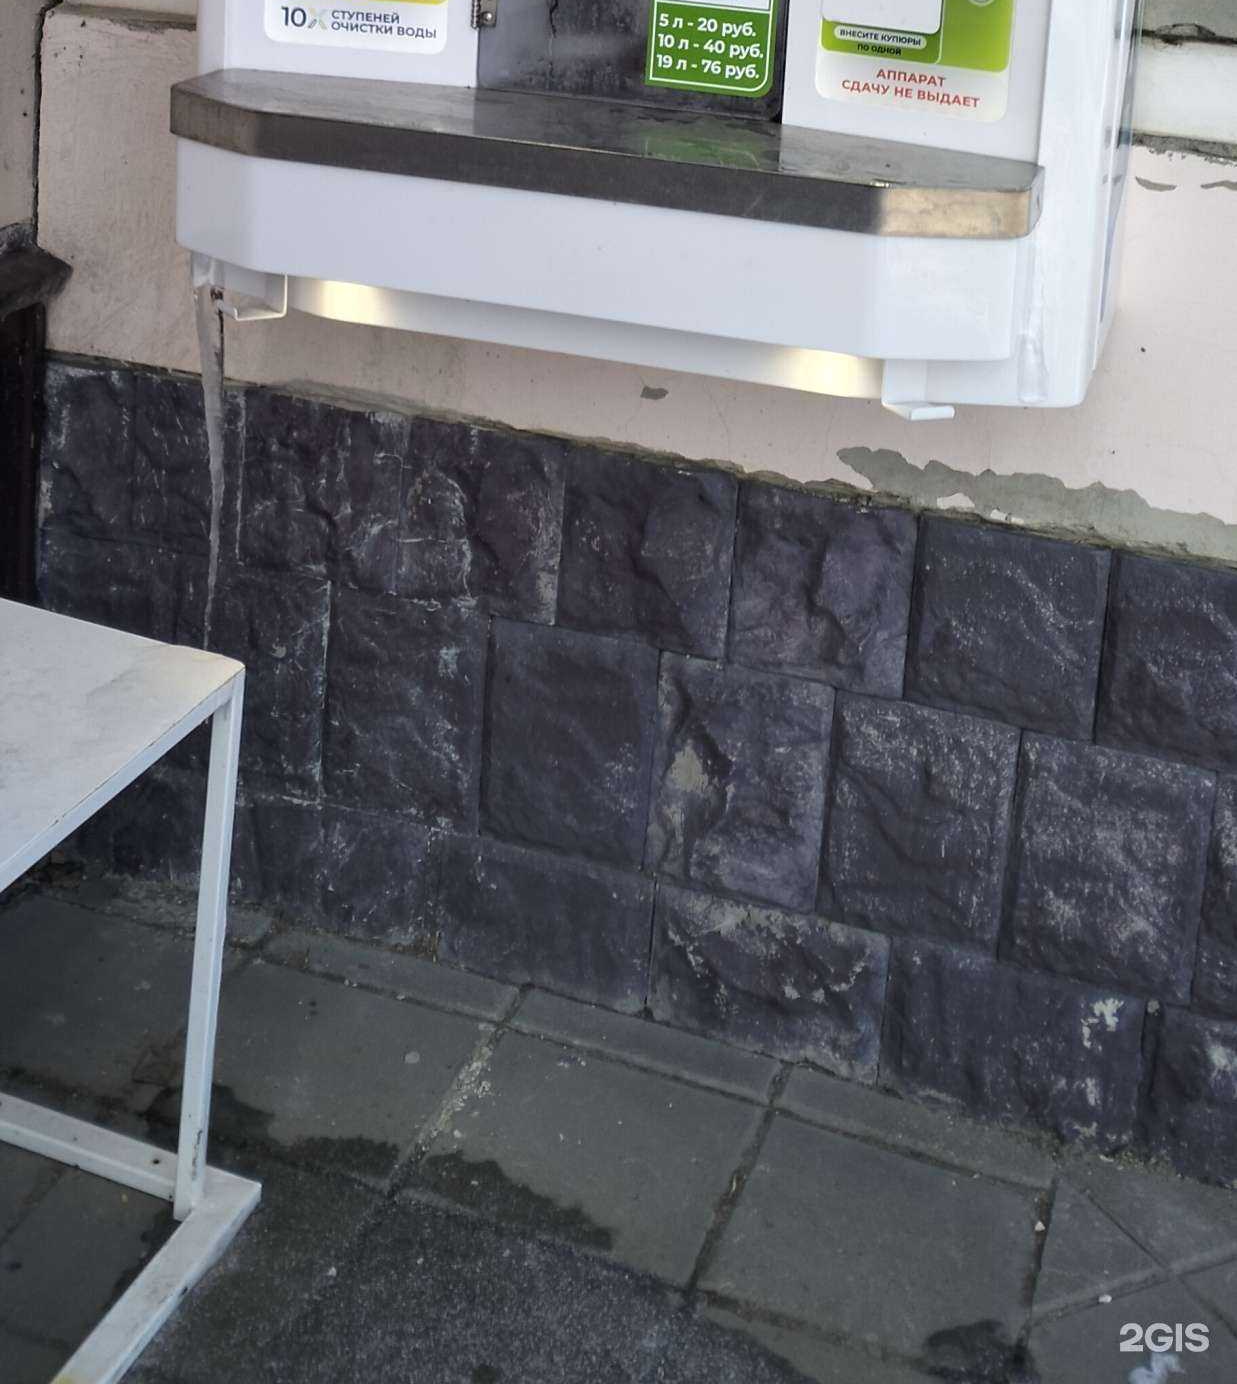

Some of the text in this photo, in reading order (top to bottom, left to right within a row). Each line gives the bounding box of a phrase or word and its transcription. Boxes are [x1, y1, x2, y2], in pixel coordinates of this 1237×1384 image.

[331, 9, 400, 24] СТУПЕНЕЙ
[659, 13, 669, 27] 5
[672, 17, 684, 29] л
[697, 18, 718, 32] 20
[722, 21, 756, 37] руб.
[331, 22, 437, 40] ОЧИСТКИ ВОДЫ
[839, 29, 922, 46] ВНЕСИТЕ КУПЮРЫ
[657, 34, 675, 48] 10
[678, 38, 689, 50] л
[703, 39, 725, 54] 40
[729, 43, 764, 59] руб.
[857, 44, 902, 56] ПО ОДНОЙ
[656, 54, 673, 69] 19
[676, 59, 687, 71] л
[701, 60, 722, 75] 76
[725, 64, 760, 80] руб.
[876, 68, 946, 87] АППАРАТ
[842, 79, 981, 108] СДАЧУ НЕ ВЫДАЕТ
